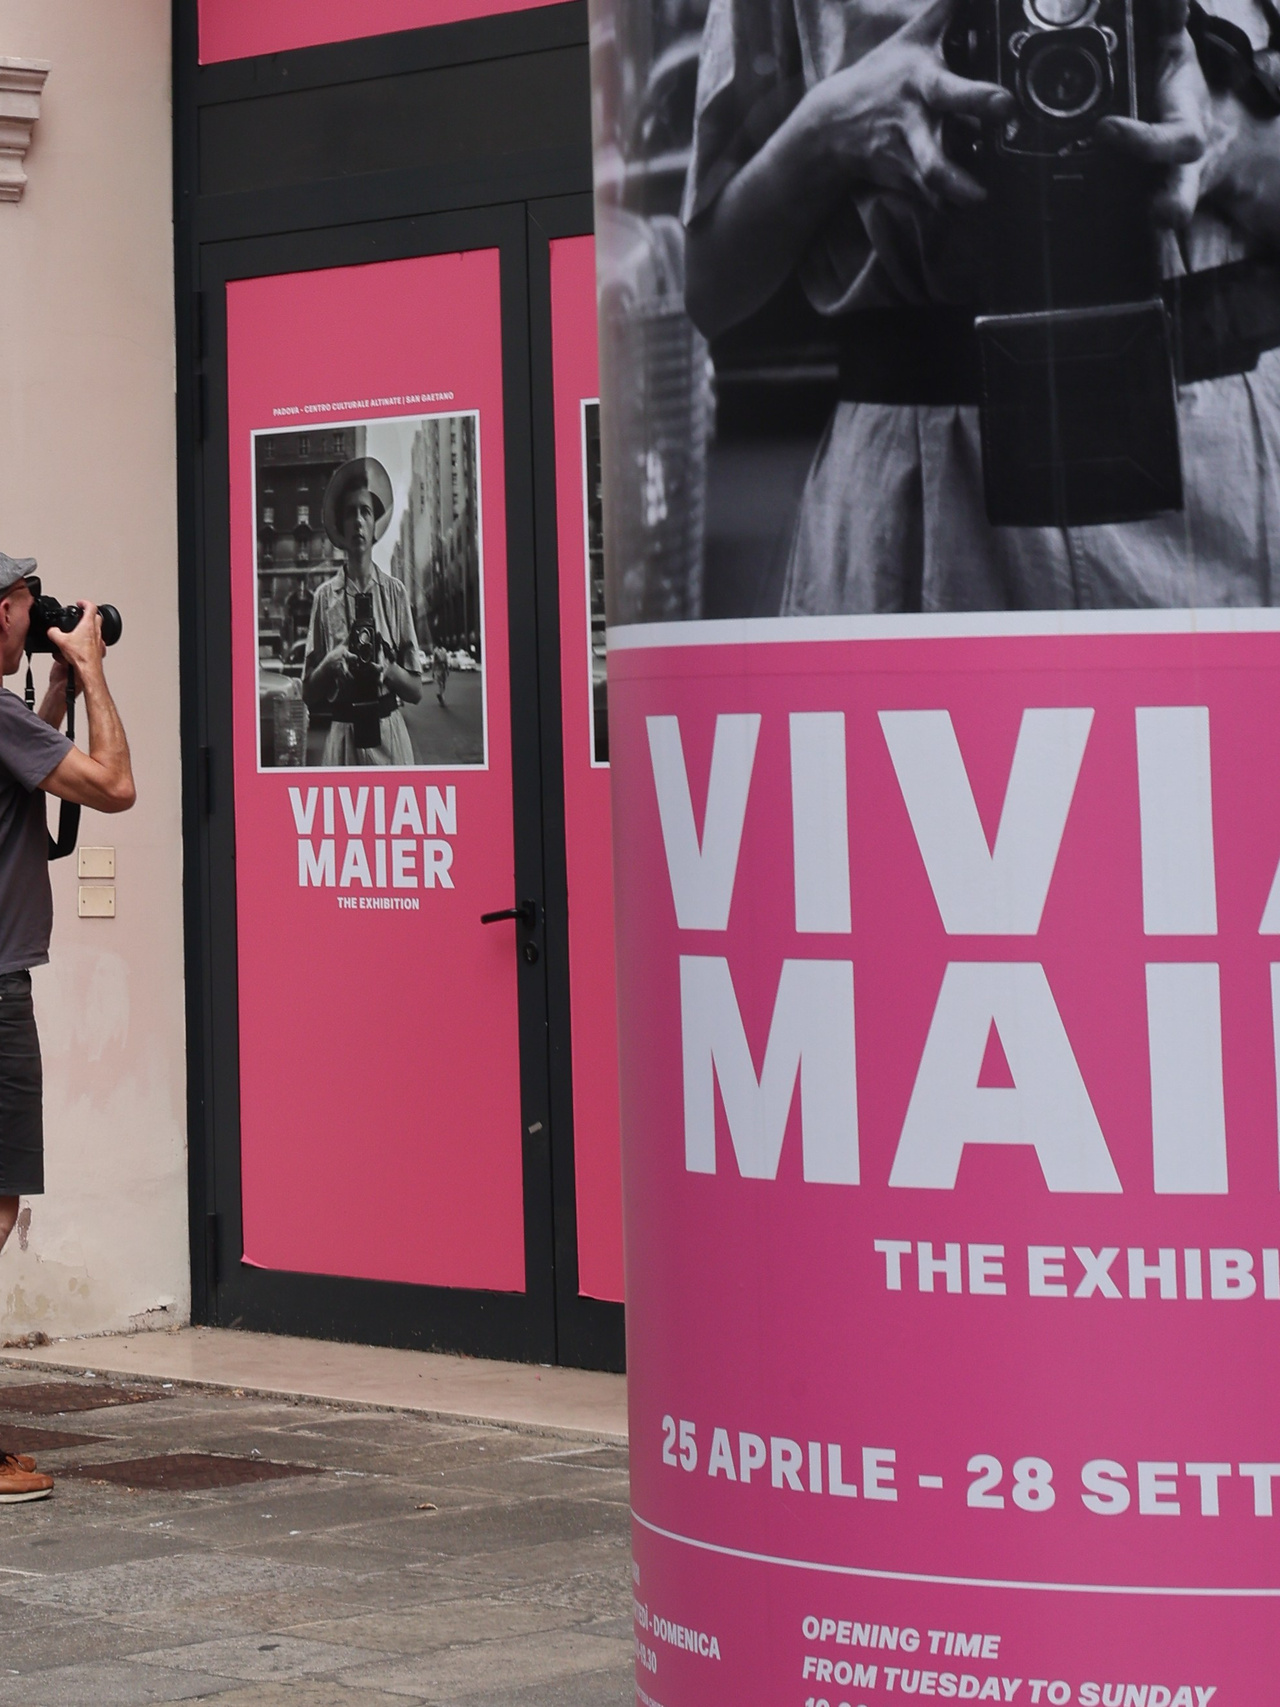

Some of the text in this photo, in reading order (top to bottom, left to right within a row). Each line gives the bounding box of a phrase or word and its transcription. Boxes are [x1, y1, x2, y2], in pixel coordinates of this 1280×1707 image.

[273, 408, 300, 417] PADOVA
[304, 404, 332, 413] CENTRO
[331, 402, 370, 411] CULTURALE
[370, 397, 402, 407] ALTINATE
[405, 396, 421, 404] SAN
[421, 391, 454, 402] GAETANO
[288, 786, 457, 834] VIVIAN
[298, 839, 455, 888] MAIER
[337, 896, 420, 910] THE EXHIBITION
[874, 1238, 1280, 1300] THE EXHIBI
[662, 1414, 697, 1472] 25
[708, 1427, 898, 1502] APRILE
[966, 1454, 1056, 1512] 28
[1081, 1459, 1280, 1517] SETT
[653, 1613, 721, 1661] DOMENICA
[802, 1615, 1001, 1659] OPENING TIME
[802, 1656, 1216, 1707] FROM TUESDAY TO SUNDAY
